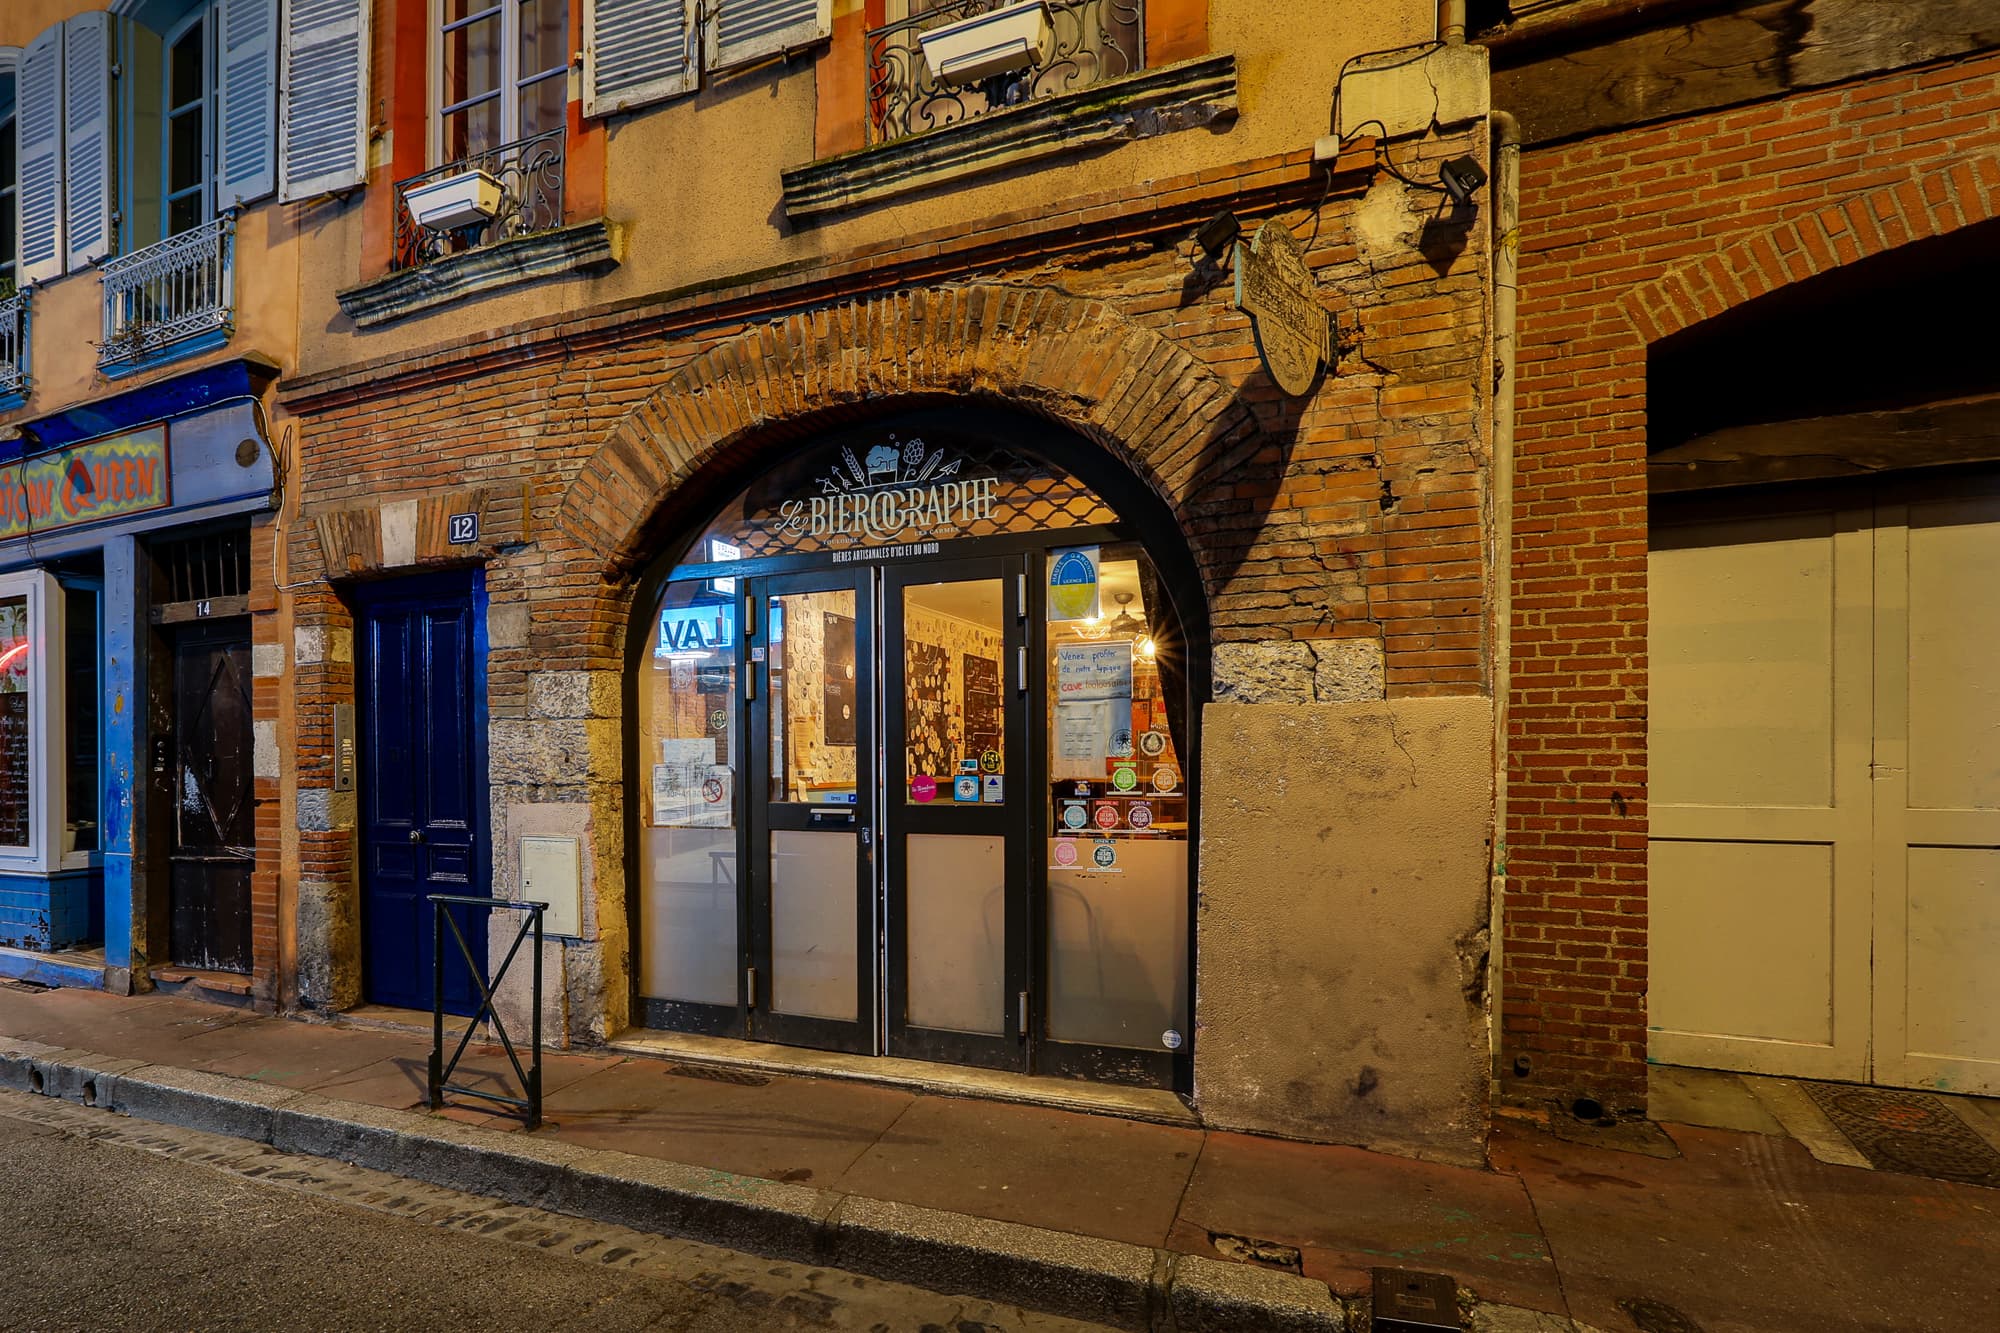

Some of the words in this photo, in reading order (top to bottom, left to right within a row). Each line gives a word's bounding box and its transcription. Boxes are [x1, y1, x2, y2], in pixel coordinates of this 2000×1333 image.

[60, 456, 157, 516] QUEEN
[774, 499, 809, 538] Le
[453, 517, 473, 539] 12
[832, 551, 851, 563] BIÈRES
[852, 547, 890, 561] ARTISANALES
[890, 546, 905, 557] D'ICI
[905, 545, 913, 556] ET
[913, 544, 922, 555] DU
[922, 542, 939, 554] NORD
[197, 601, 210, 617] 14
[1060, 651, 1085, 661] Venez
[1062, 665, 1071, 673] de
[1061, 681, 1083, 692] cave
